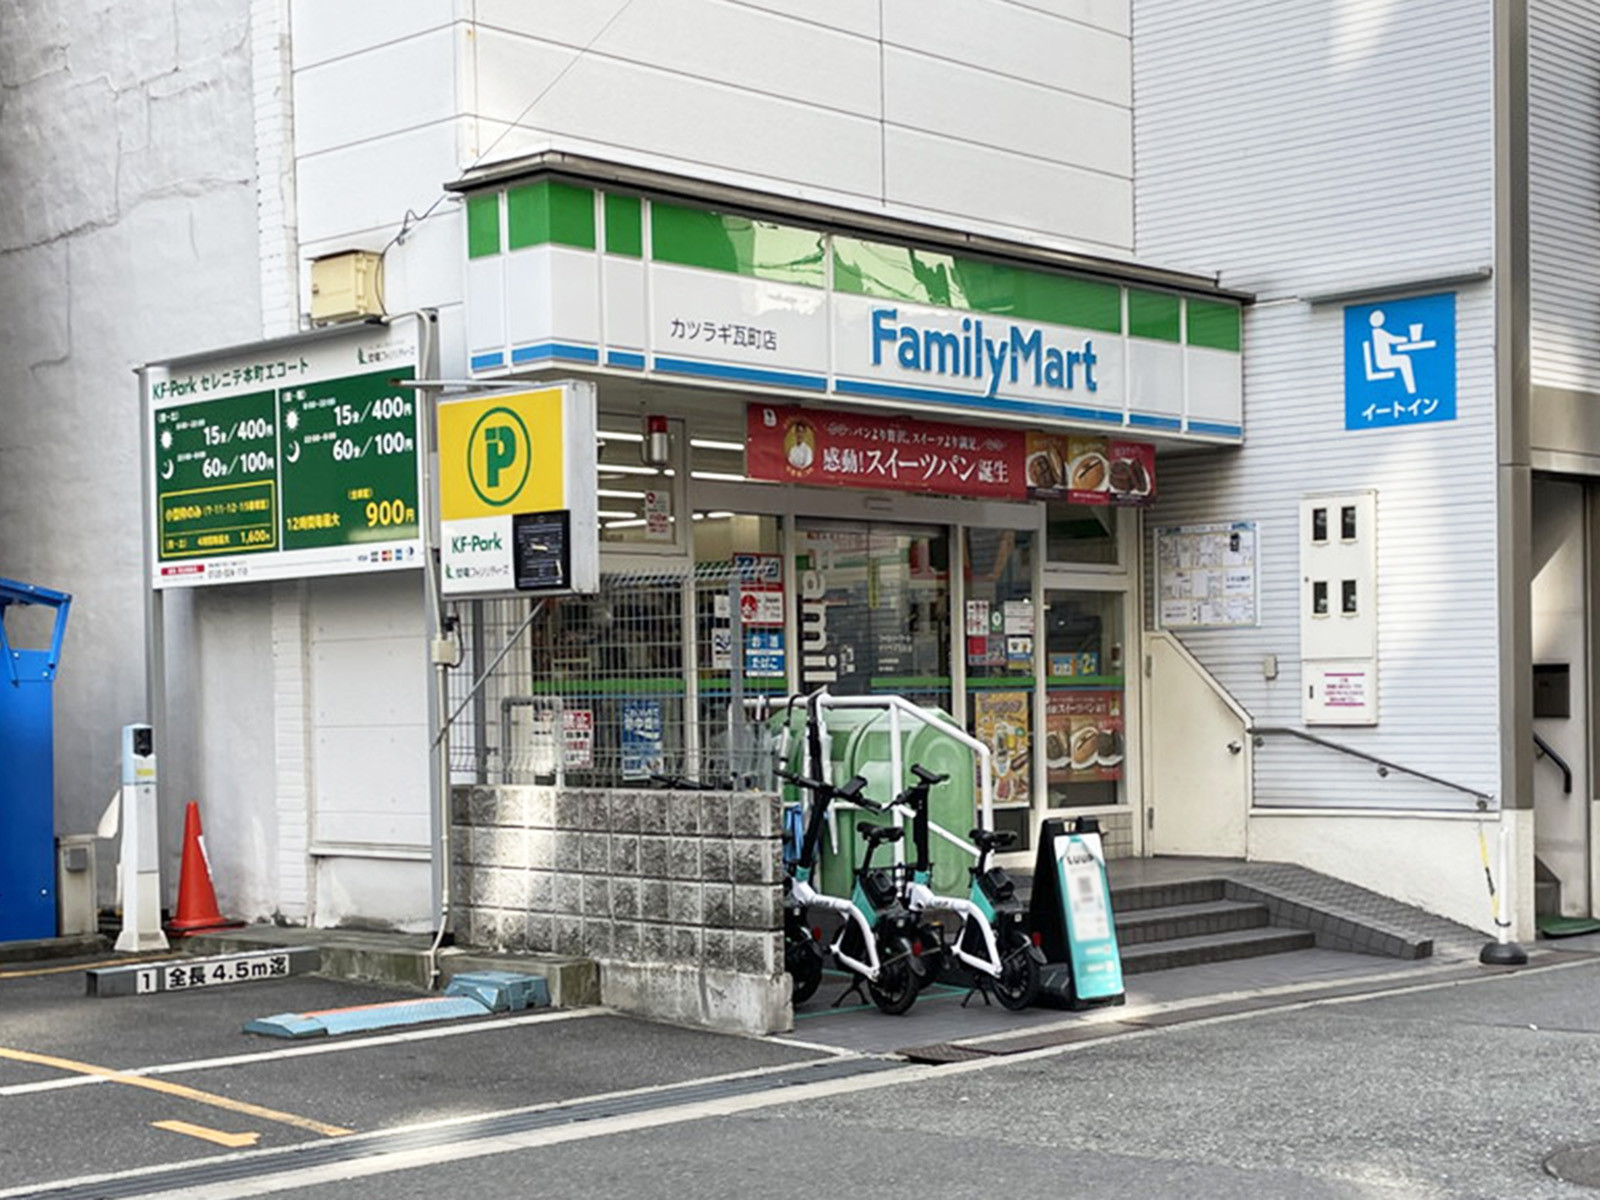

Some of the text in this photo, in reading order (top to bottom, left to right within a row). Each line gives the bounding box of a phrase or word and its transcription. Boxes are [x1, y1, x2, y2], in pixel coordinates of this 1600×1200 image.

[670, 317, 778, 352] カツラギ瓦町店
[870, 307, 1098, 397] FamilyMart
[152, 358, 309, 400] KF-Park セレニテ本町エコート
[1362, 398, 1438, 421] イートイン
[366, 499, 415, 528] 900円
[451, 531, 503, 554] KF-Park
[142, 972, 150, 990] 1
